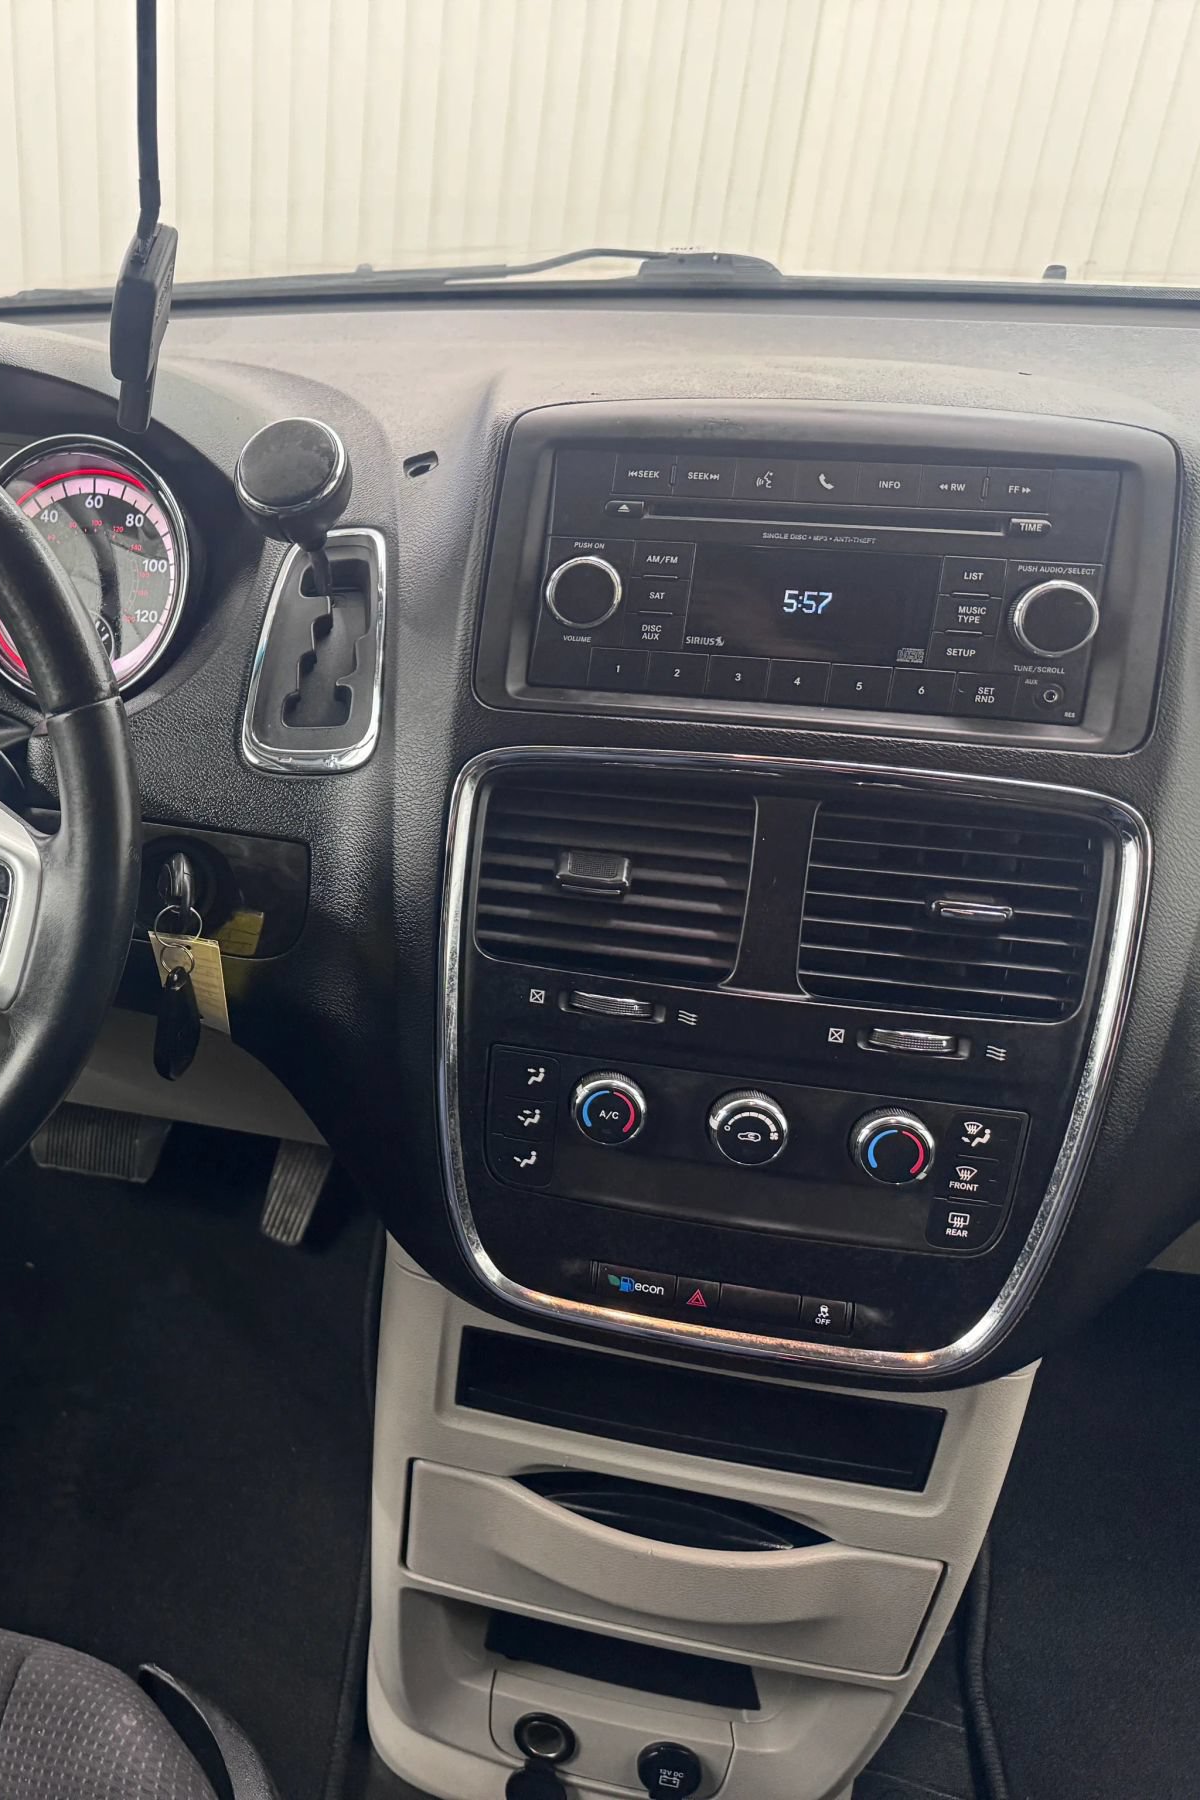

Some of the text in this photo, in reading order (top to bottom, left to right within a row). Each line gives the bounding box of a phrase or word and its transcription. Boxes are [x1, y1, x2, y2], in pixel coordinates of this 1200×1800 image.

[638, 470, 660, 478] SEEK
[688, 472, 709, 480] SEEK
[879, 480, 900, 489] INFO
[1008, 486, 1019, 494] FF
[85, 495, 103, 508] 60
[40, 510, 58, 522] 40
[126, 514, 144, 527] 80
[1020, 523, 1042, 532] TIME
[646, 556, 678, 564] AM/FM
[143, 559, 167, 572] 100
[1018, 565, 1095, 575] PUSH AUDIO/SELECT
[964, 572, 984, 580] LIST
[783, 590, 832, 614] 5:57
[958, 606, 986, 615] MUSIC
[134, 610, 158, 623] 120
[958, 615, 980, 624] TYPE
[642, 624, 662, 632] DISC
[642, 632, 660, 640] AUX
[686, 636, 714, 645] SIRIUS
[946, 648, 976, 657] SETUP
[674, 669, 680, 677] 2
[1013, 665, 1065, 674] TUNE/SCROLL
[735, 672, 741, 681] 3
[794, 677, 800, 686] 4
[856, 682, 862, 691] 5
[918, 686, 924, 694] 6
[978, 687, 995, 695] SET
[975, 695, 995, 703] RND
[599, 1110, 619, 1120] A/C
[949, 1181, 979, 1191] FRONT
[946, 1228, 968, 1237] REAR
[634, 1283, 664, 1296] econ
[815, 1317, 831, 1325] OFF
